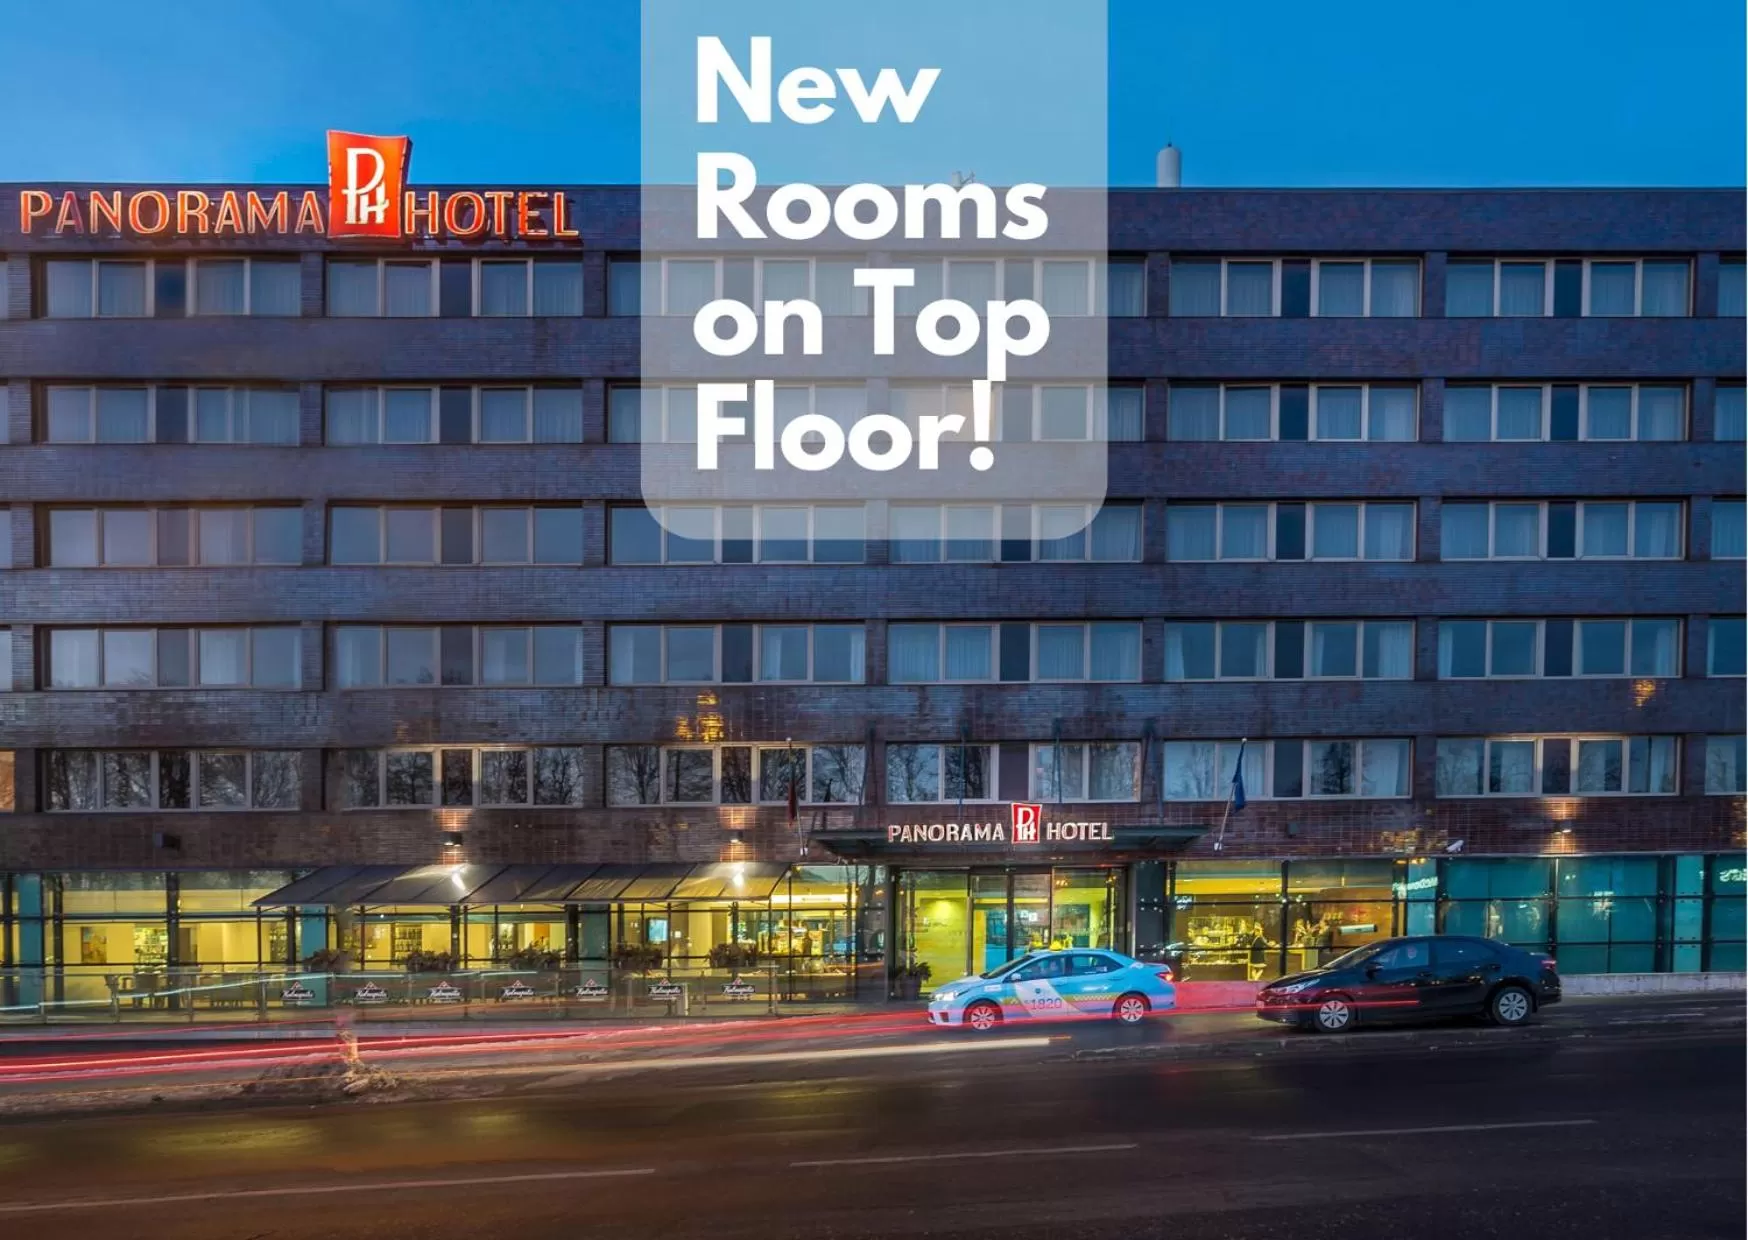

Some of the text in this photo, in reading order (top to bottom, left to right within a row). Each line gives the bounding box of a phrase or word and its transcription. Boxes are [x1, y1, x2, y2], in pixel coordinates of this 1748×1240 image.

[20, 190, 325, 234] PANORAMA
[404, 191, 580, 236] HOTEL
[887, 823, 1005, 842] PANORAMA
[1046, 822, 1115, 841] HOTEL
[1032, 998, 1063, 1010] 1820
